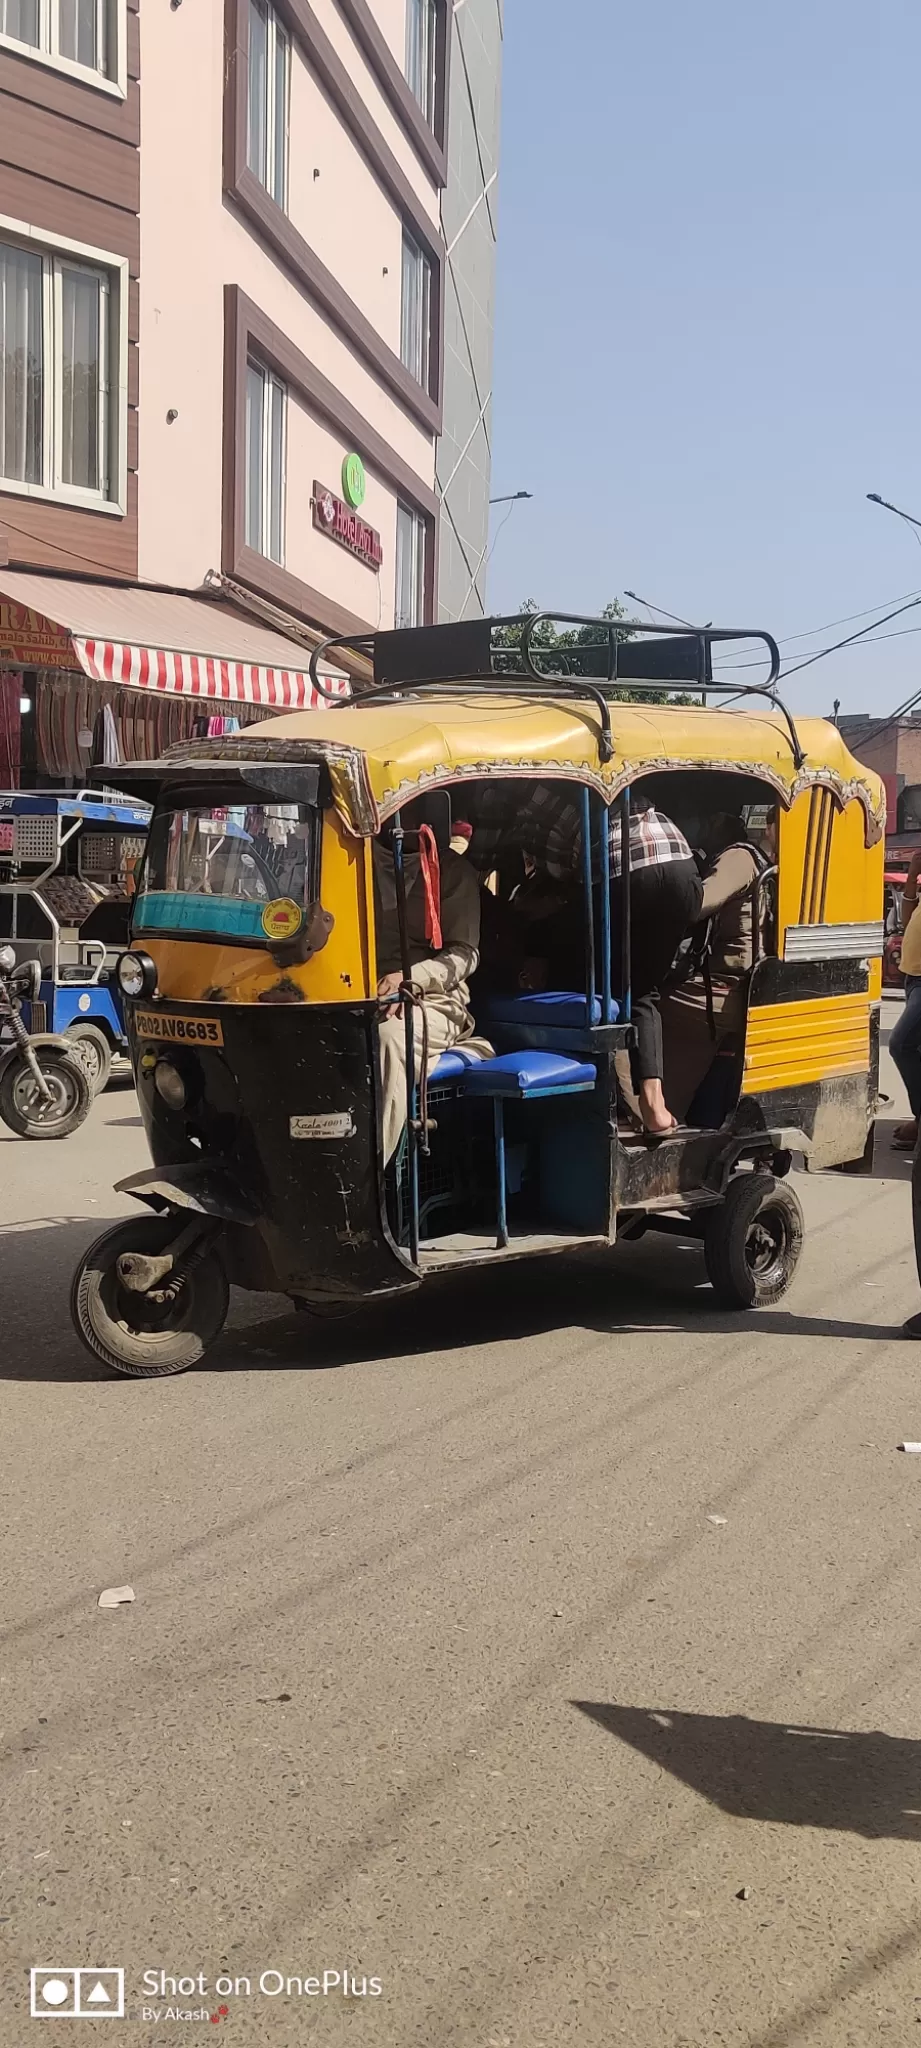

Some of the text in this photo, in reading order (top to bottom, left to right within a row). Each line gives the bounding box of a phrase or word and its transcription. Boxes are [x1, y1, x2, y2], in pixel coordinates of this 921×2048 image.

[333, 500, 356, 545] Hotel
[27, 634, 58, 648] Sahib,
[136, 1015, 219, 1041] PB02AV8683
